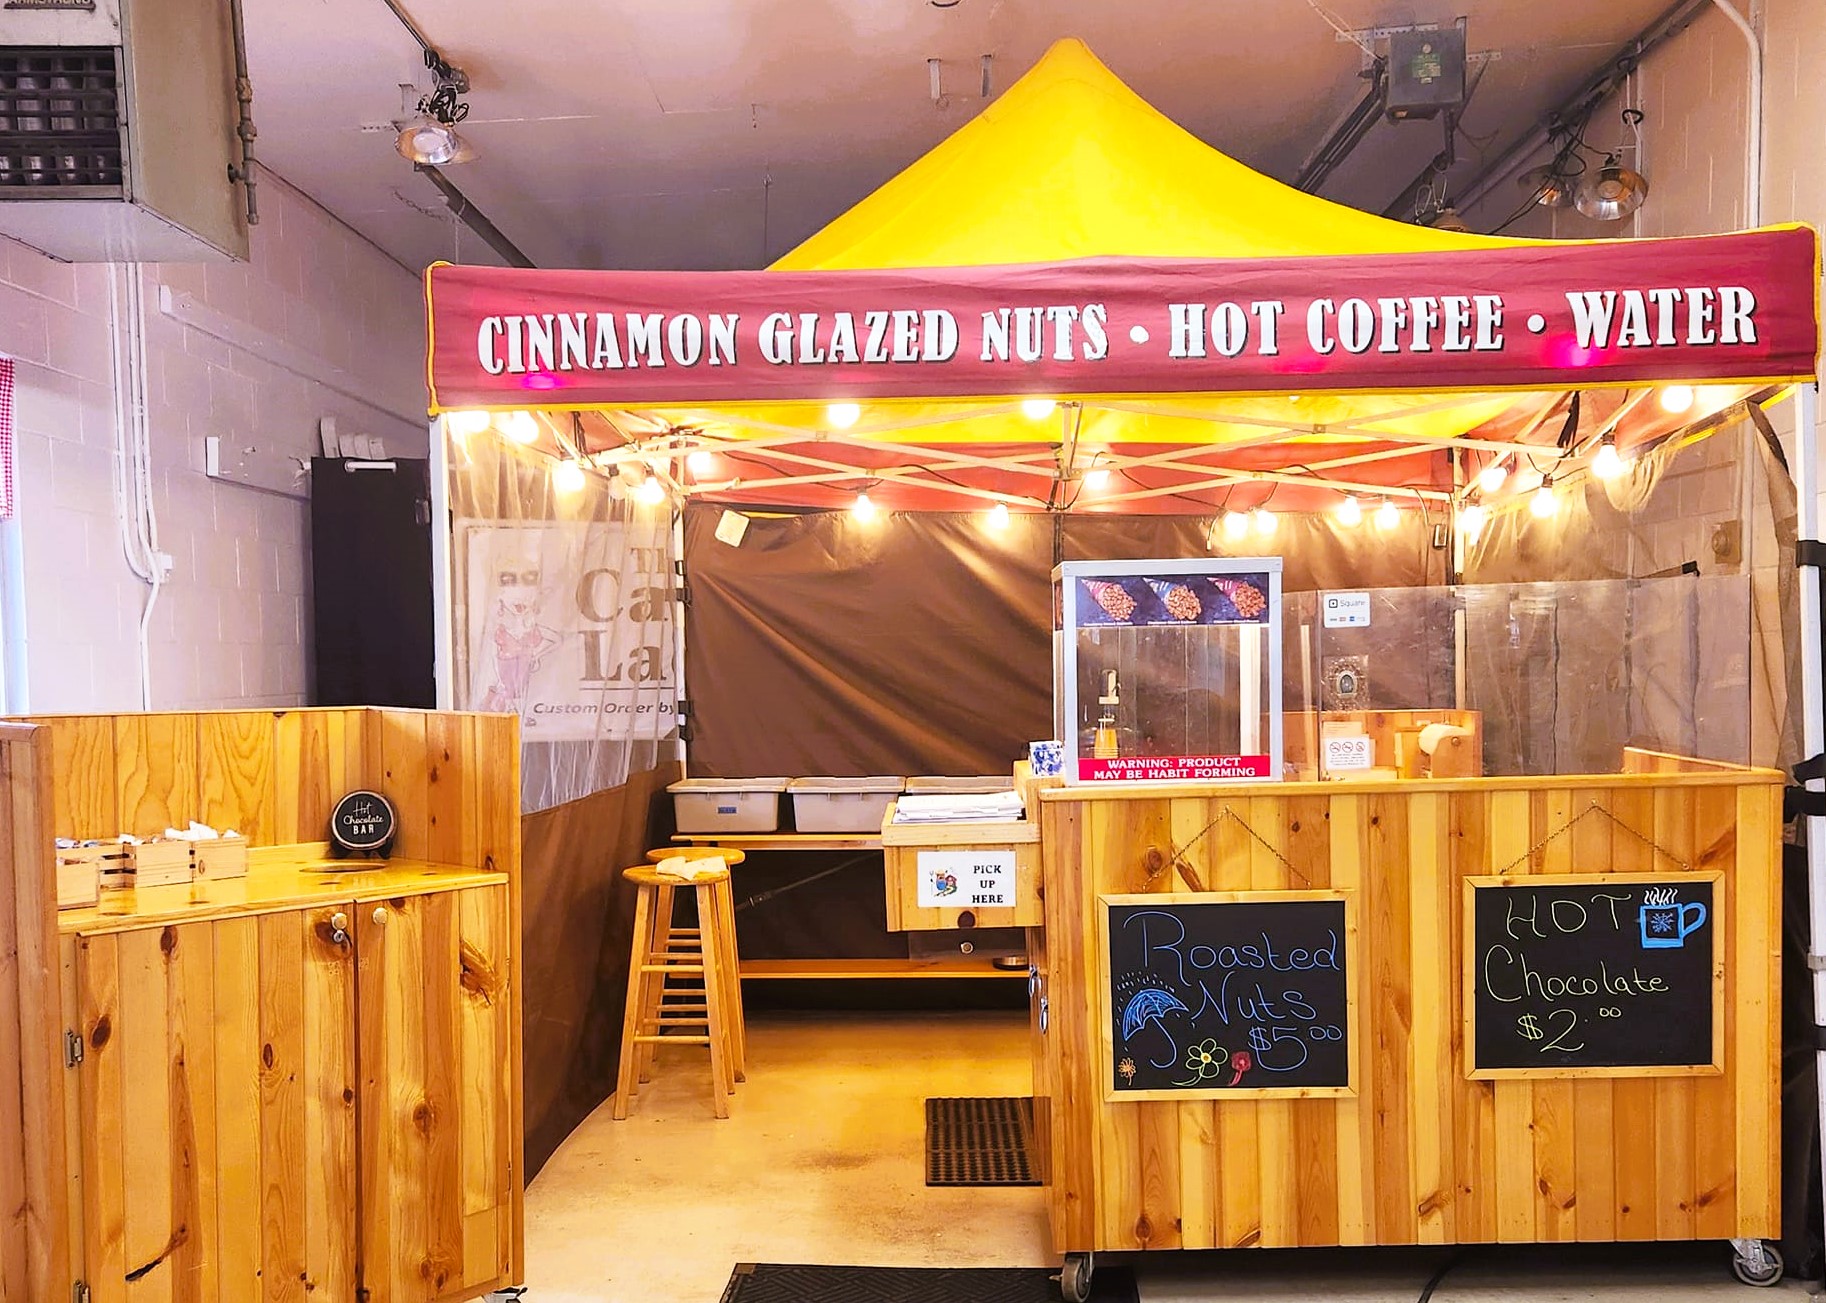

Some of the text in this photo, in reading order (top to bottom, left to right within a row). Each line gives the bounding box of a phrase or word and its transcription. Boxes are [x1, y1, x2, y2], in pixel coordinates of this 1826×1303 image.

[477, 286, 1758, 375] CINNAMON GLAZED NUTS HOT COFFEE WATER
[533, 701, 675, 716] Custom Order by
[1107, 757, 1241, 769] WARNING: PRODUCT
[1093, 766, 1256, 780] MAY BE HABIT FORMING
[353, 801, 373, 817] Hot
[343, 814, 384, 825] Chocolate
[353, 824, 374, 835] BAR
[973, 865, 1002, 874] PICK
[979, 880, 996, 889] UP
[972, 895, 1004, 904] HERE
[1506, 893, 1632, 940] HOT
[1123, 911, 1340, 986] Roasted
[1485, 944, 1669, 1002] Chocolate
[1191, 970, 1317, 1025] Nuts
